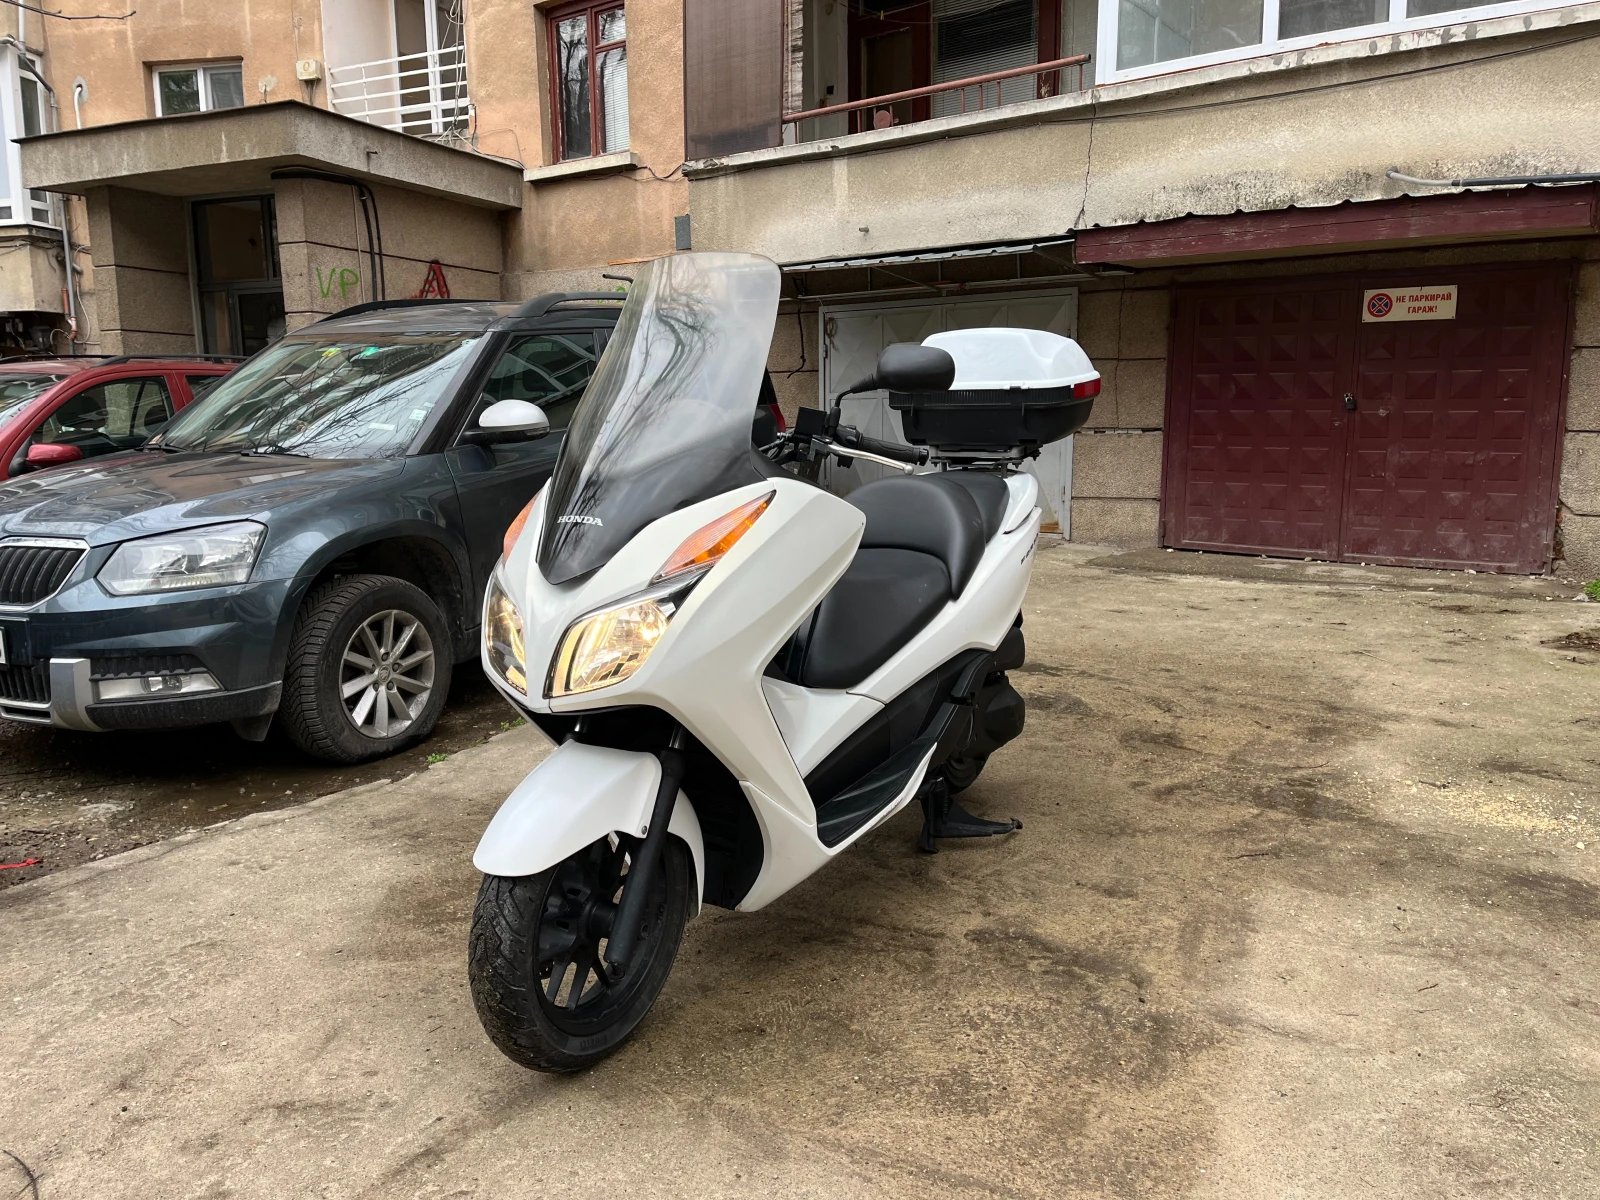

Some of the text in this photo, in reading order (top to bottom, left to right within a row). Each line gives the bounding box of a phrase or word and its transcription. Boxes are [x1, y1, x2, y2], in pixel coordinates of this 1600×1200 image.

[316, 267, 360, 300] VP
[1395, 291, 1452, 304] НЕ ПАРКИРАЙ
[1407, 305, 1438, 314] ГАРАЖ!
[556, 515, 604, 527] HONDA
